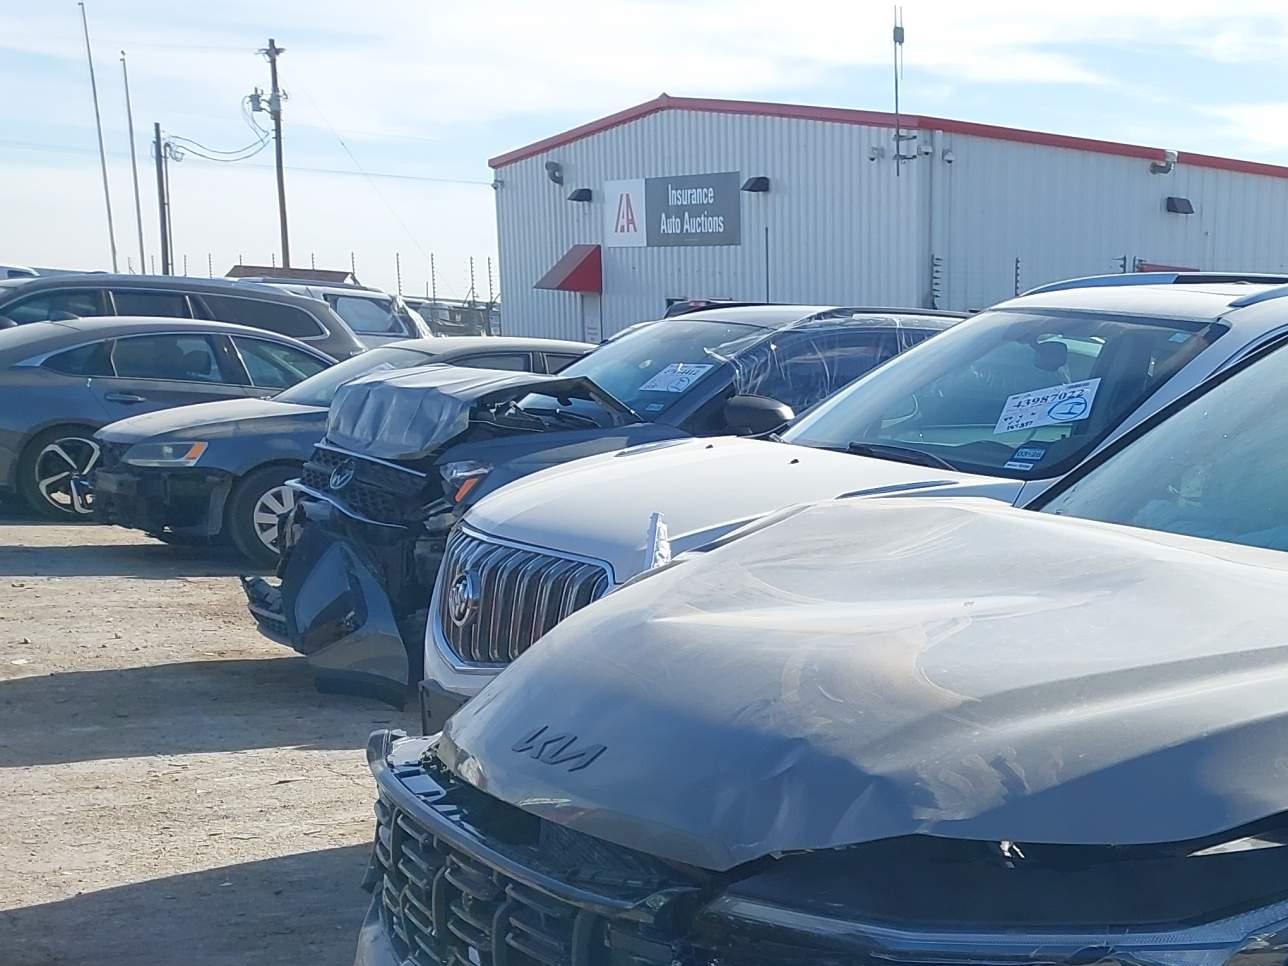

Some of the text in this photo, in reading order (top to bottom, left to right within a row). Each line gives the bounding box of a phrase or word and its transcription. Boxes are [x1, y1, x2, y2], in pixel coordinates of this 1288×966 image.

[668, 184, 714, 206] Insurance
[660, 210, 724, 234] Auto Auctions
[511, 725, 608, 773] KIA
